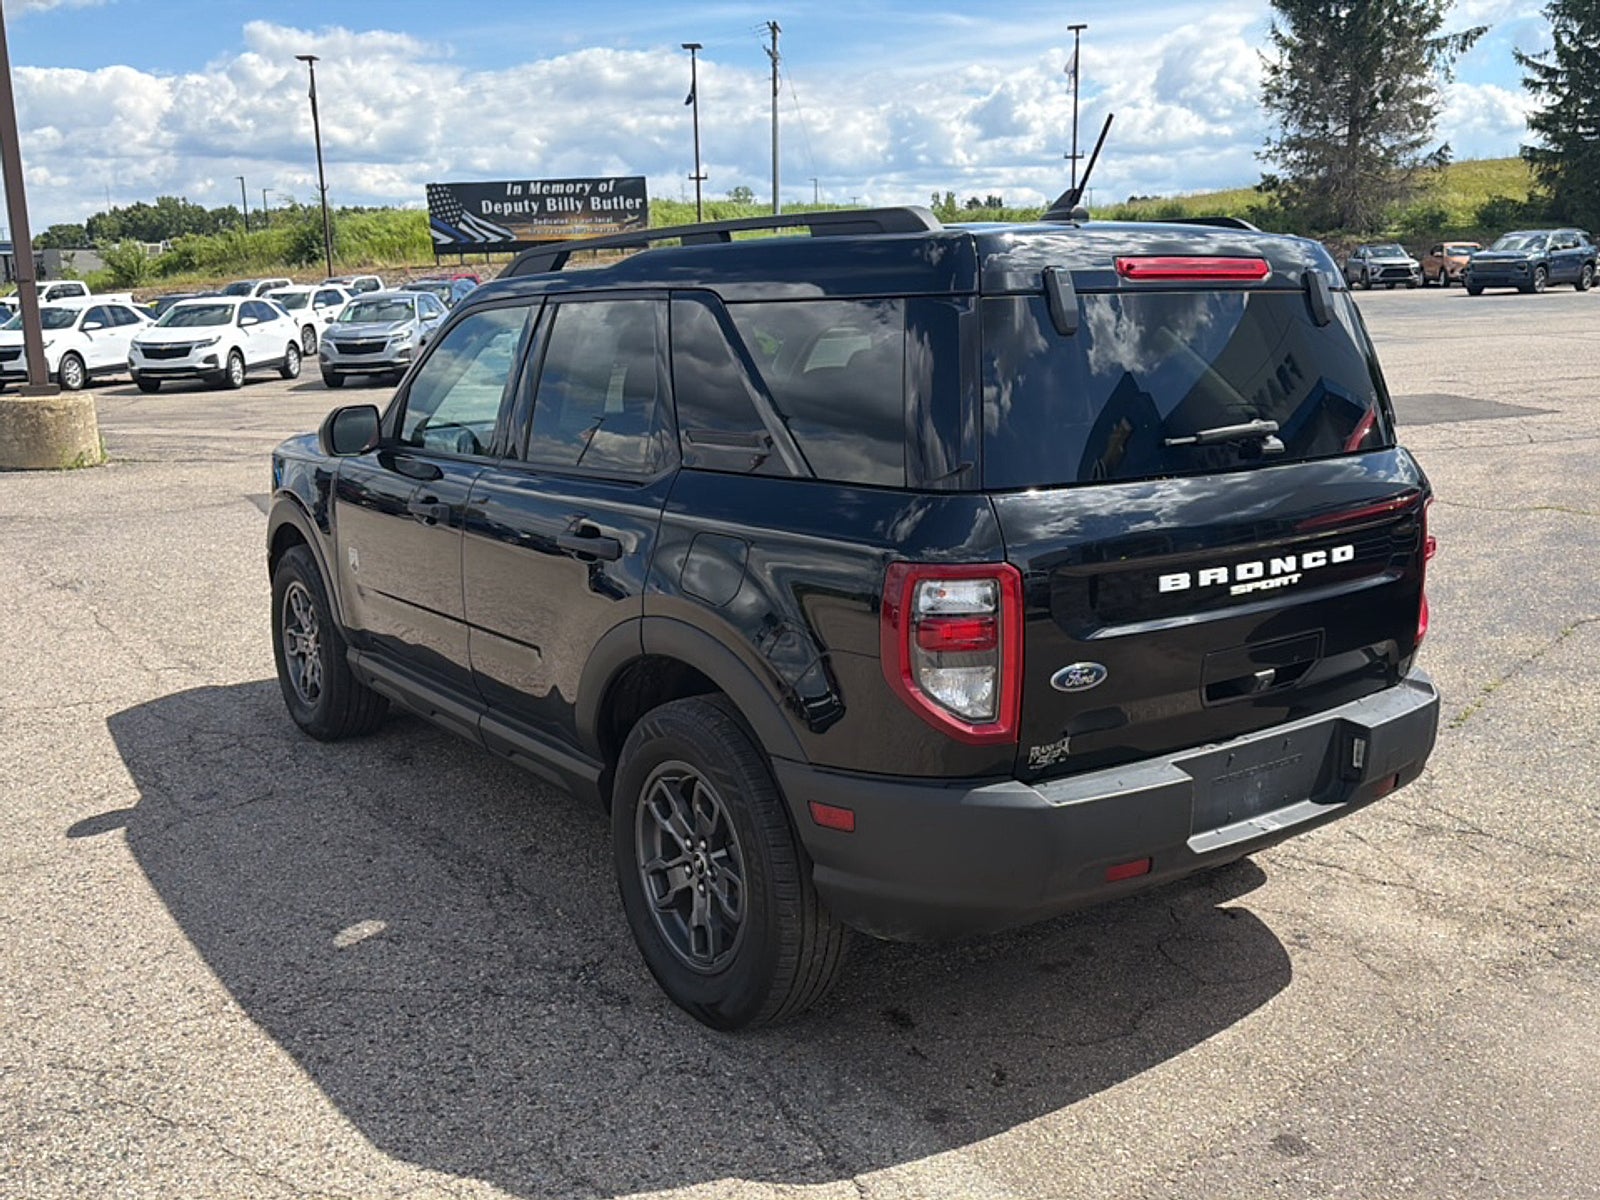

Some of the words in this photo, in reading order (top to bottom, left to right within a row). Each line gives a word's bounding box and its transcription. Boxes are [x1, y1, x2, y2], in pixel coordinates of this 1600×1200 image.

[506, 182, 522, 196] In
[529, 180, 592, 197] Memory
[598, 179, 616, 193] of
[481, 198, 540, 216] Deputy
[546, 196, 585, 215] Billy
[590, 195, 643, 212] Butler
[1158, 544, 1354, 593] BRONCO
[1229, 573, 1302, 596] SPORT
